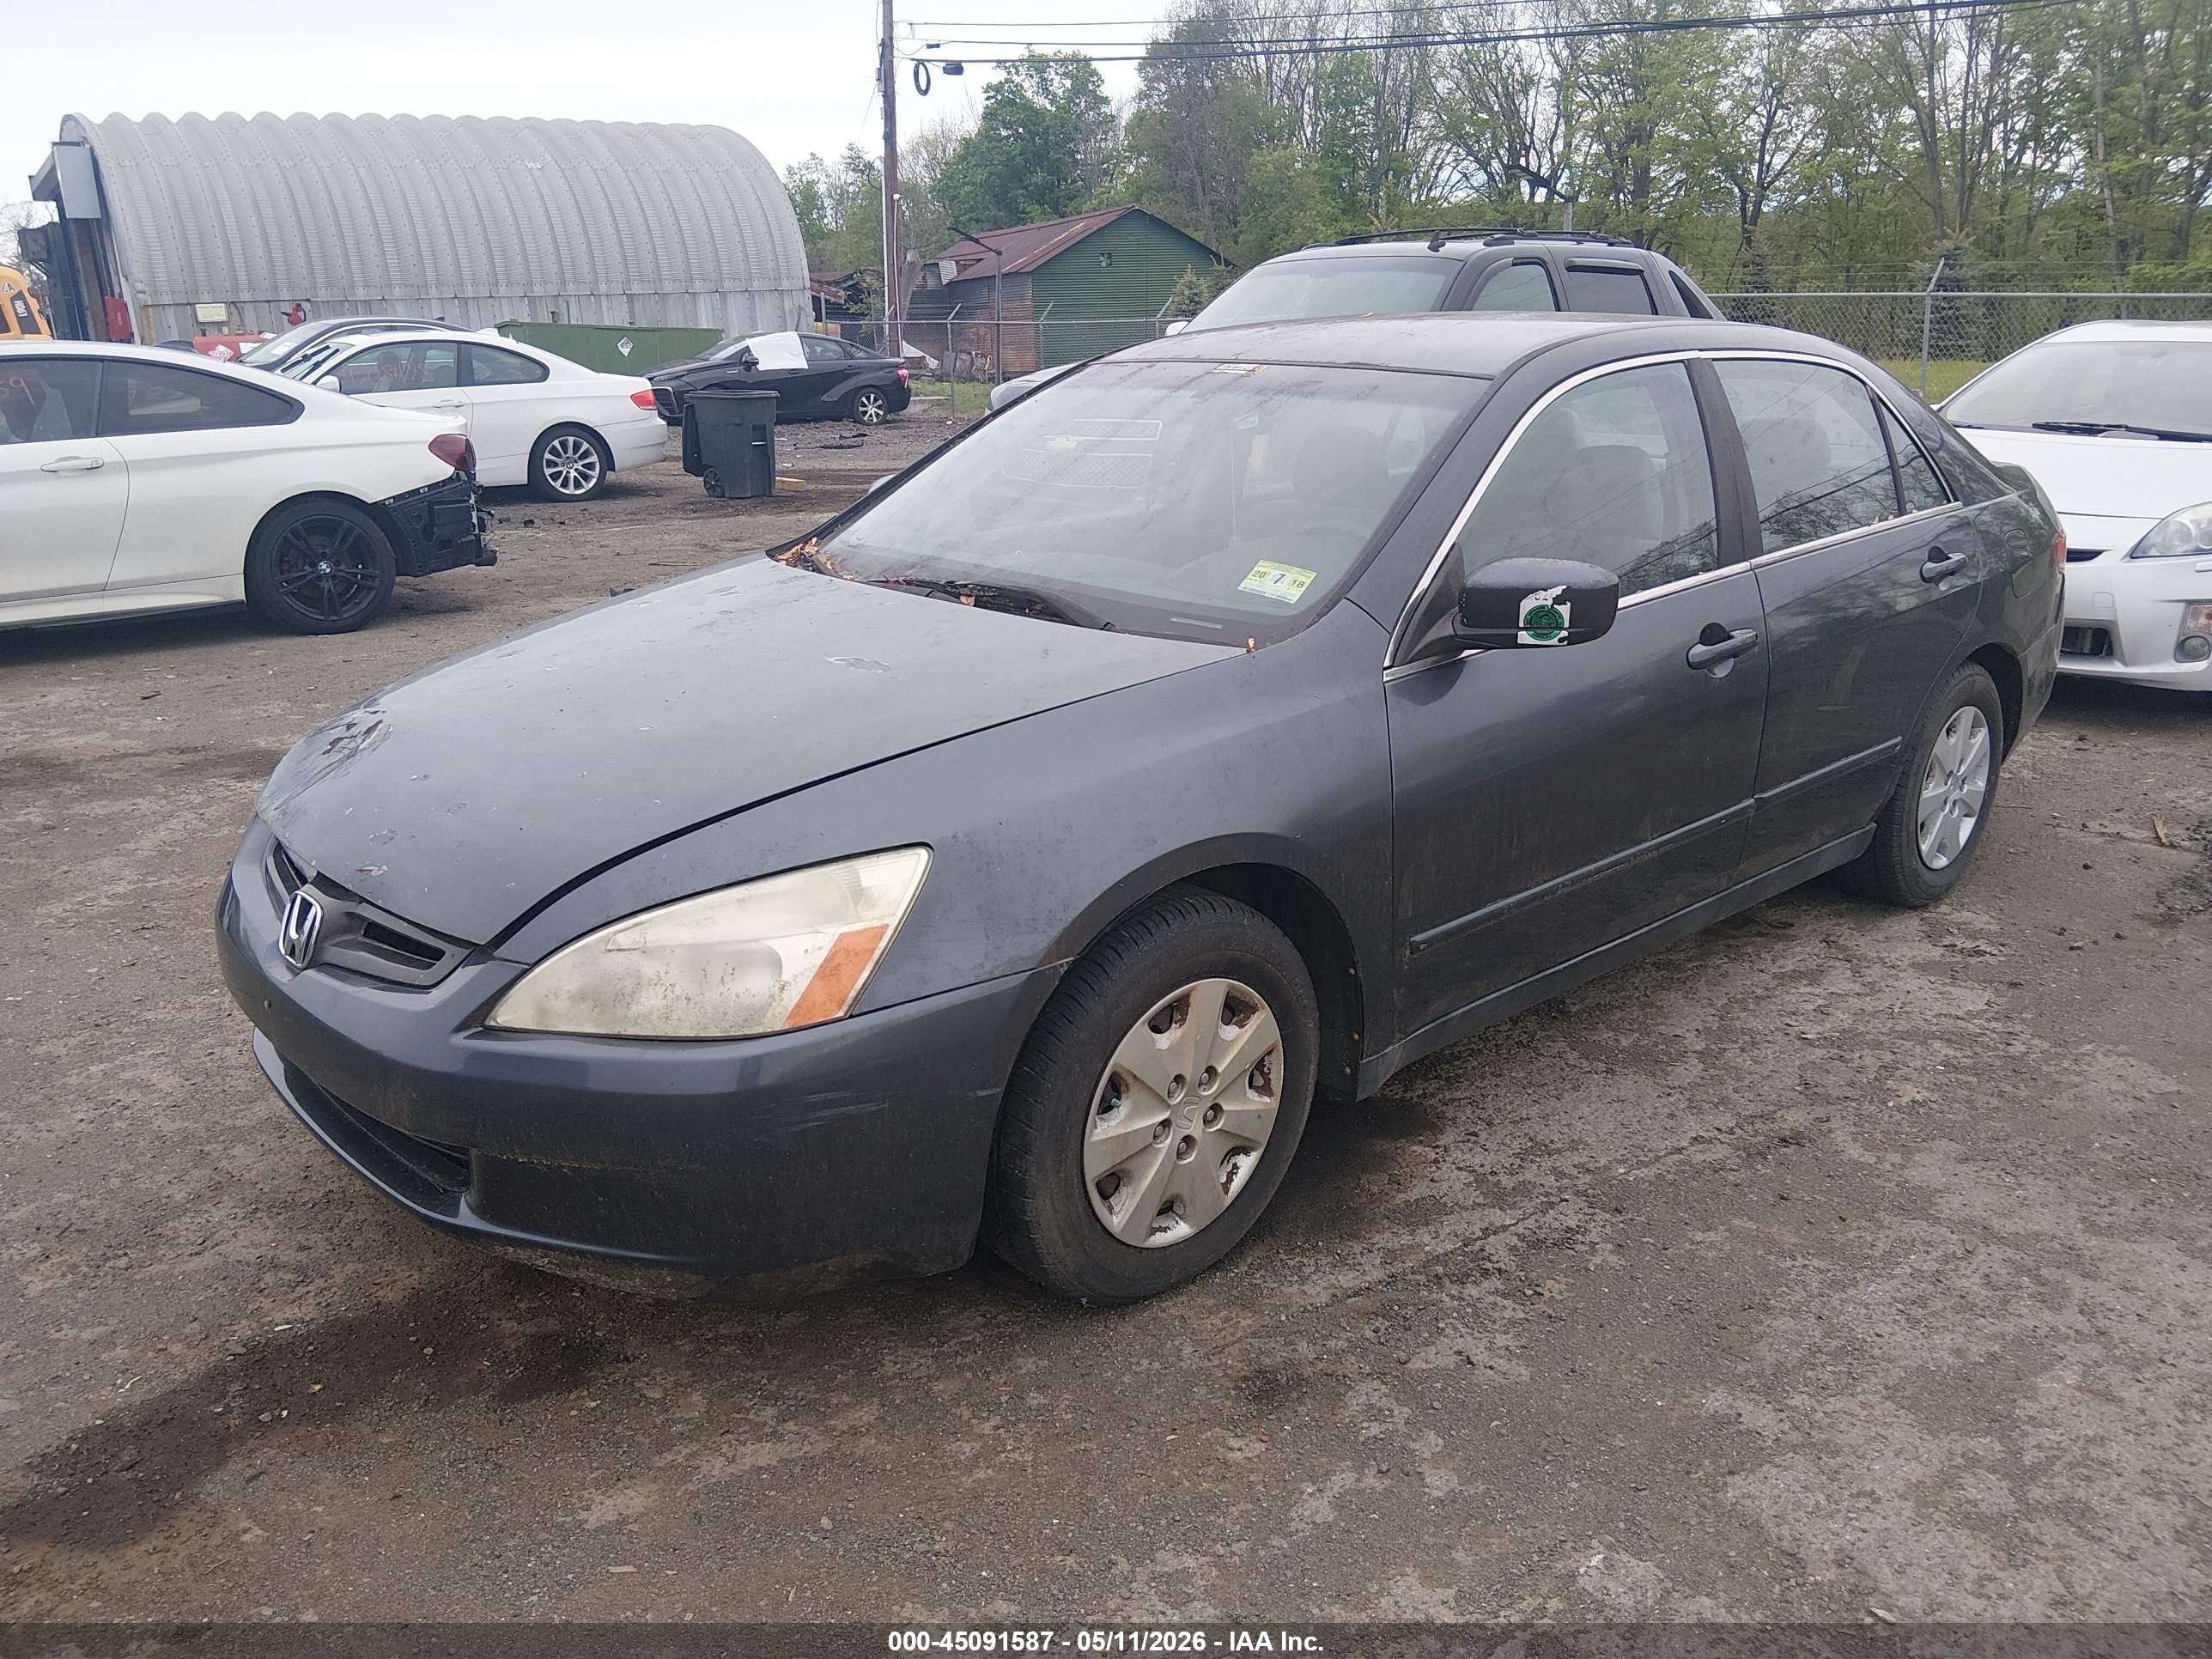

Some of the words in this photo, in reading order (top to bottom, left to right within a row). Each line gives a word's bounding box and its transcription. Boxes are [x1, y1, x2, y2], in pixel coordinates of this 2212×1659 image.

[1251, 569, 1267, 579] 20
[1273, 573, 1286, 585] 7
[1291, 579, 1306, 588] 18
